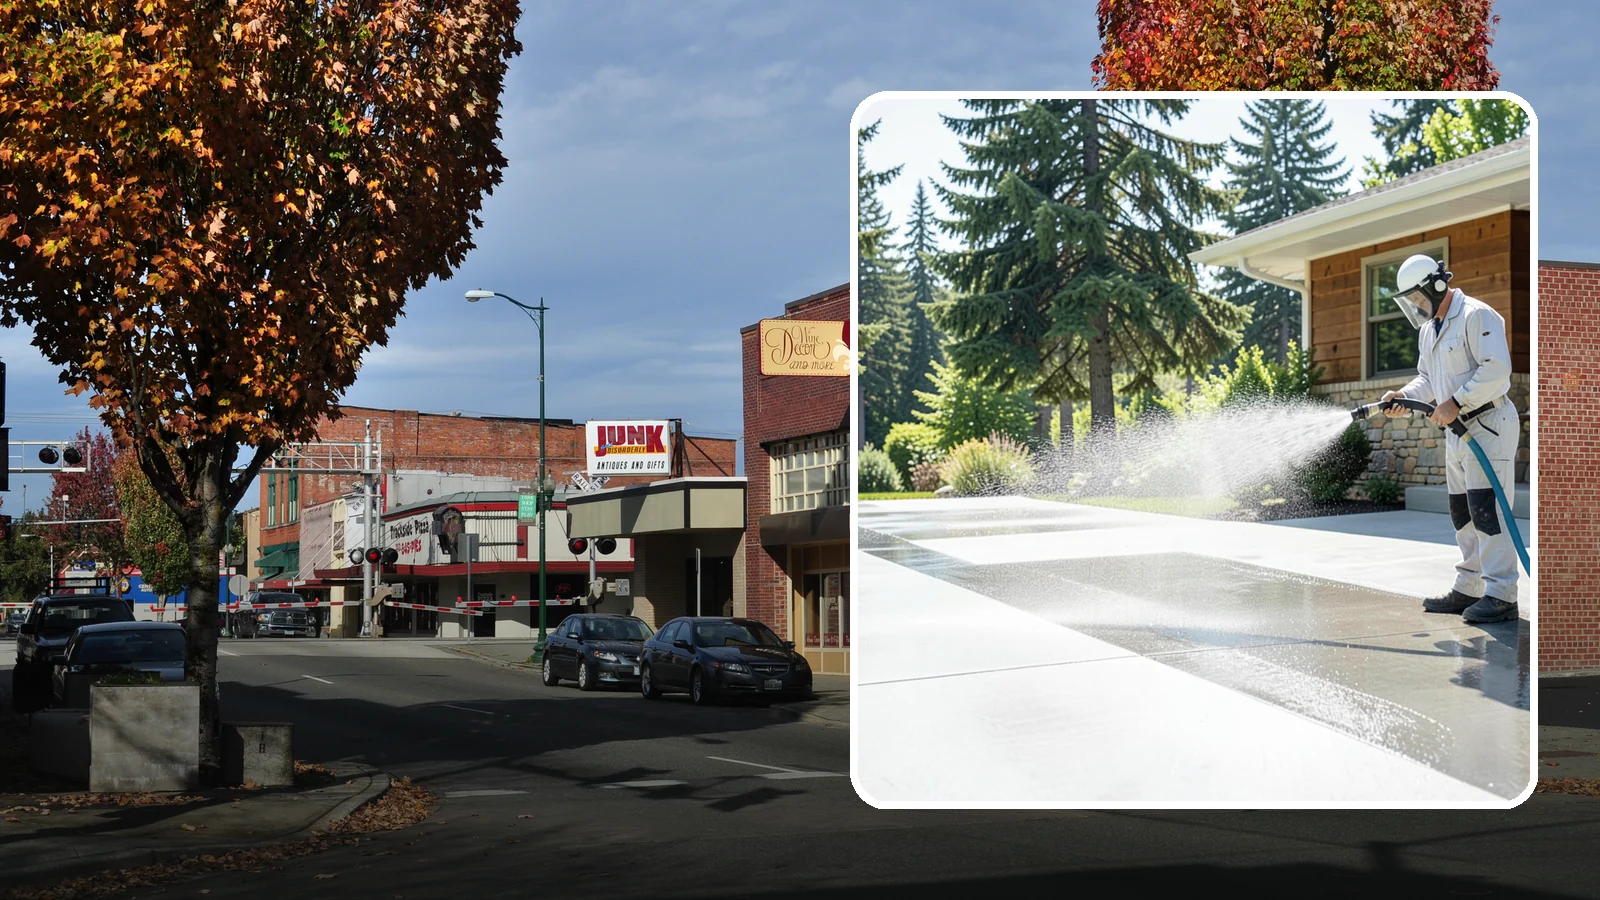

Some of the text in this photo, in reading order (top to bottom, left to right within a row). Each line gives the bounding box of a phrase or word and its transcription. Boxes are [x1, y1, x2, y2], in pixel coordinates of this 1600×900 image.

[595, 425, 665, 457] JUNK
[607, 446, 646, 454] DISORDERLY
[597, 460, 665, 470] ANTIQUES AND GIFTS
[414, 519, 429, 535] Pizza
